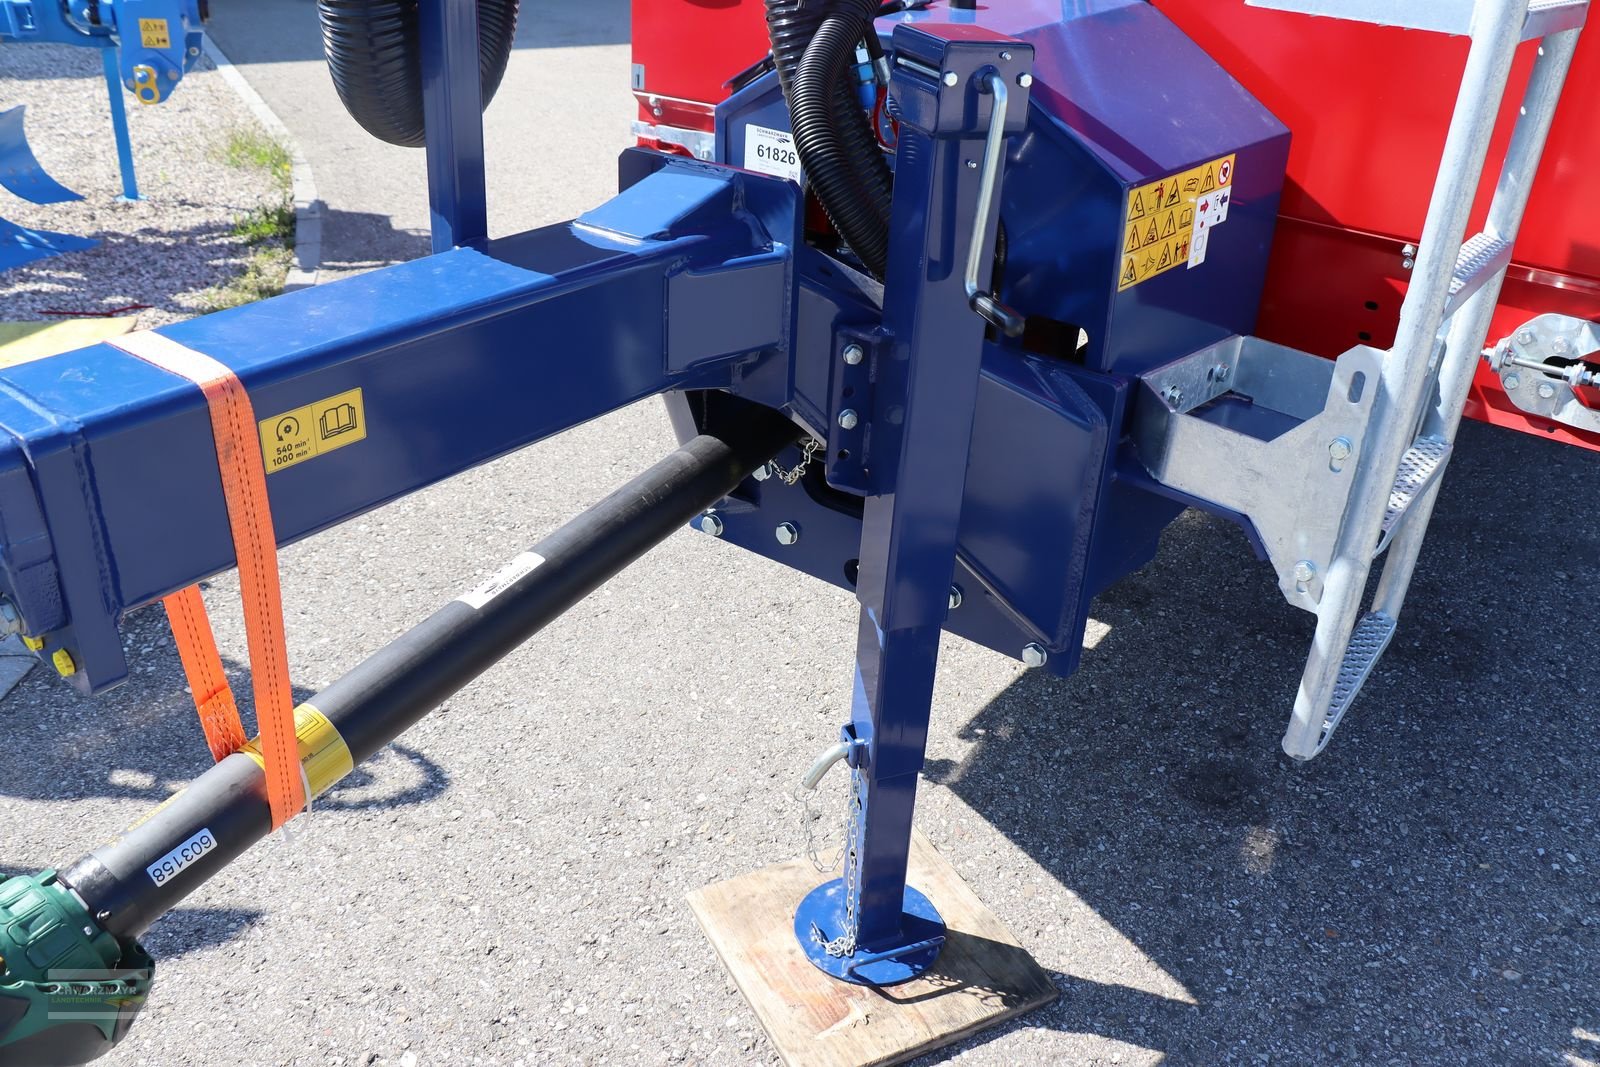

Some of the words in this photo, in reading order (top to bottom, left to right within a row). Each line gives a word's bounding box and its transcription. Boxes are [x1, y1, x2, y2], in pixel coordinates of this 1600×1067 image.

[757, 144, 796, 165] 61826
[276, 443, 293, 456] 540
[272, 453, 294, 466] 1000
[152, 835, 212, 882] 603158
